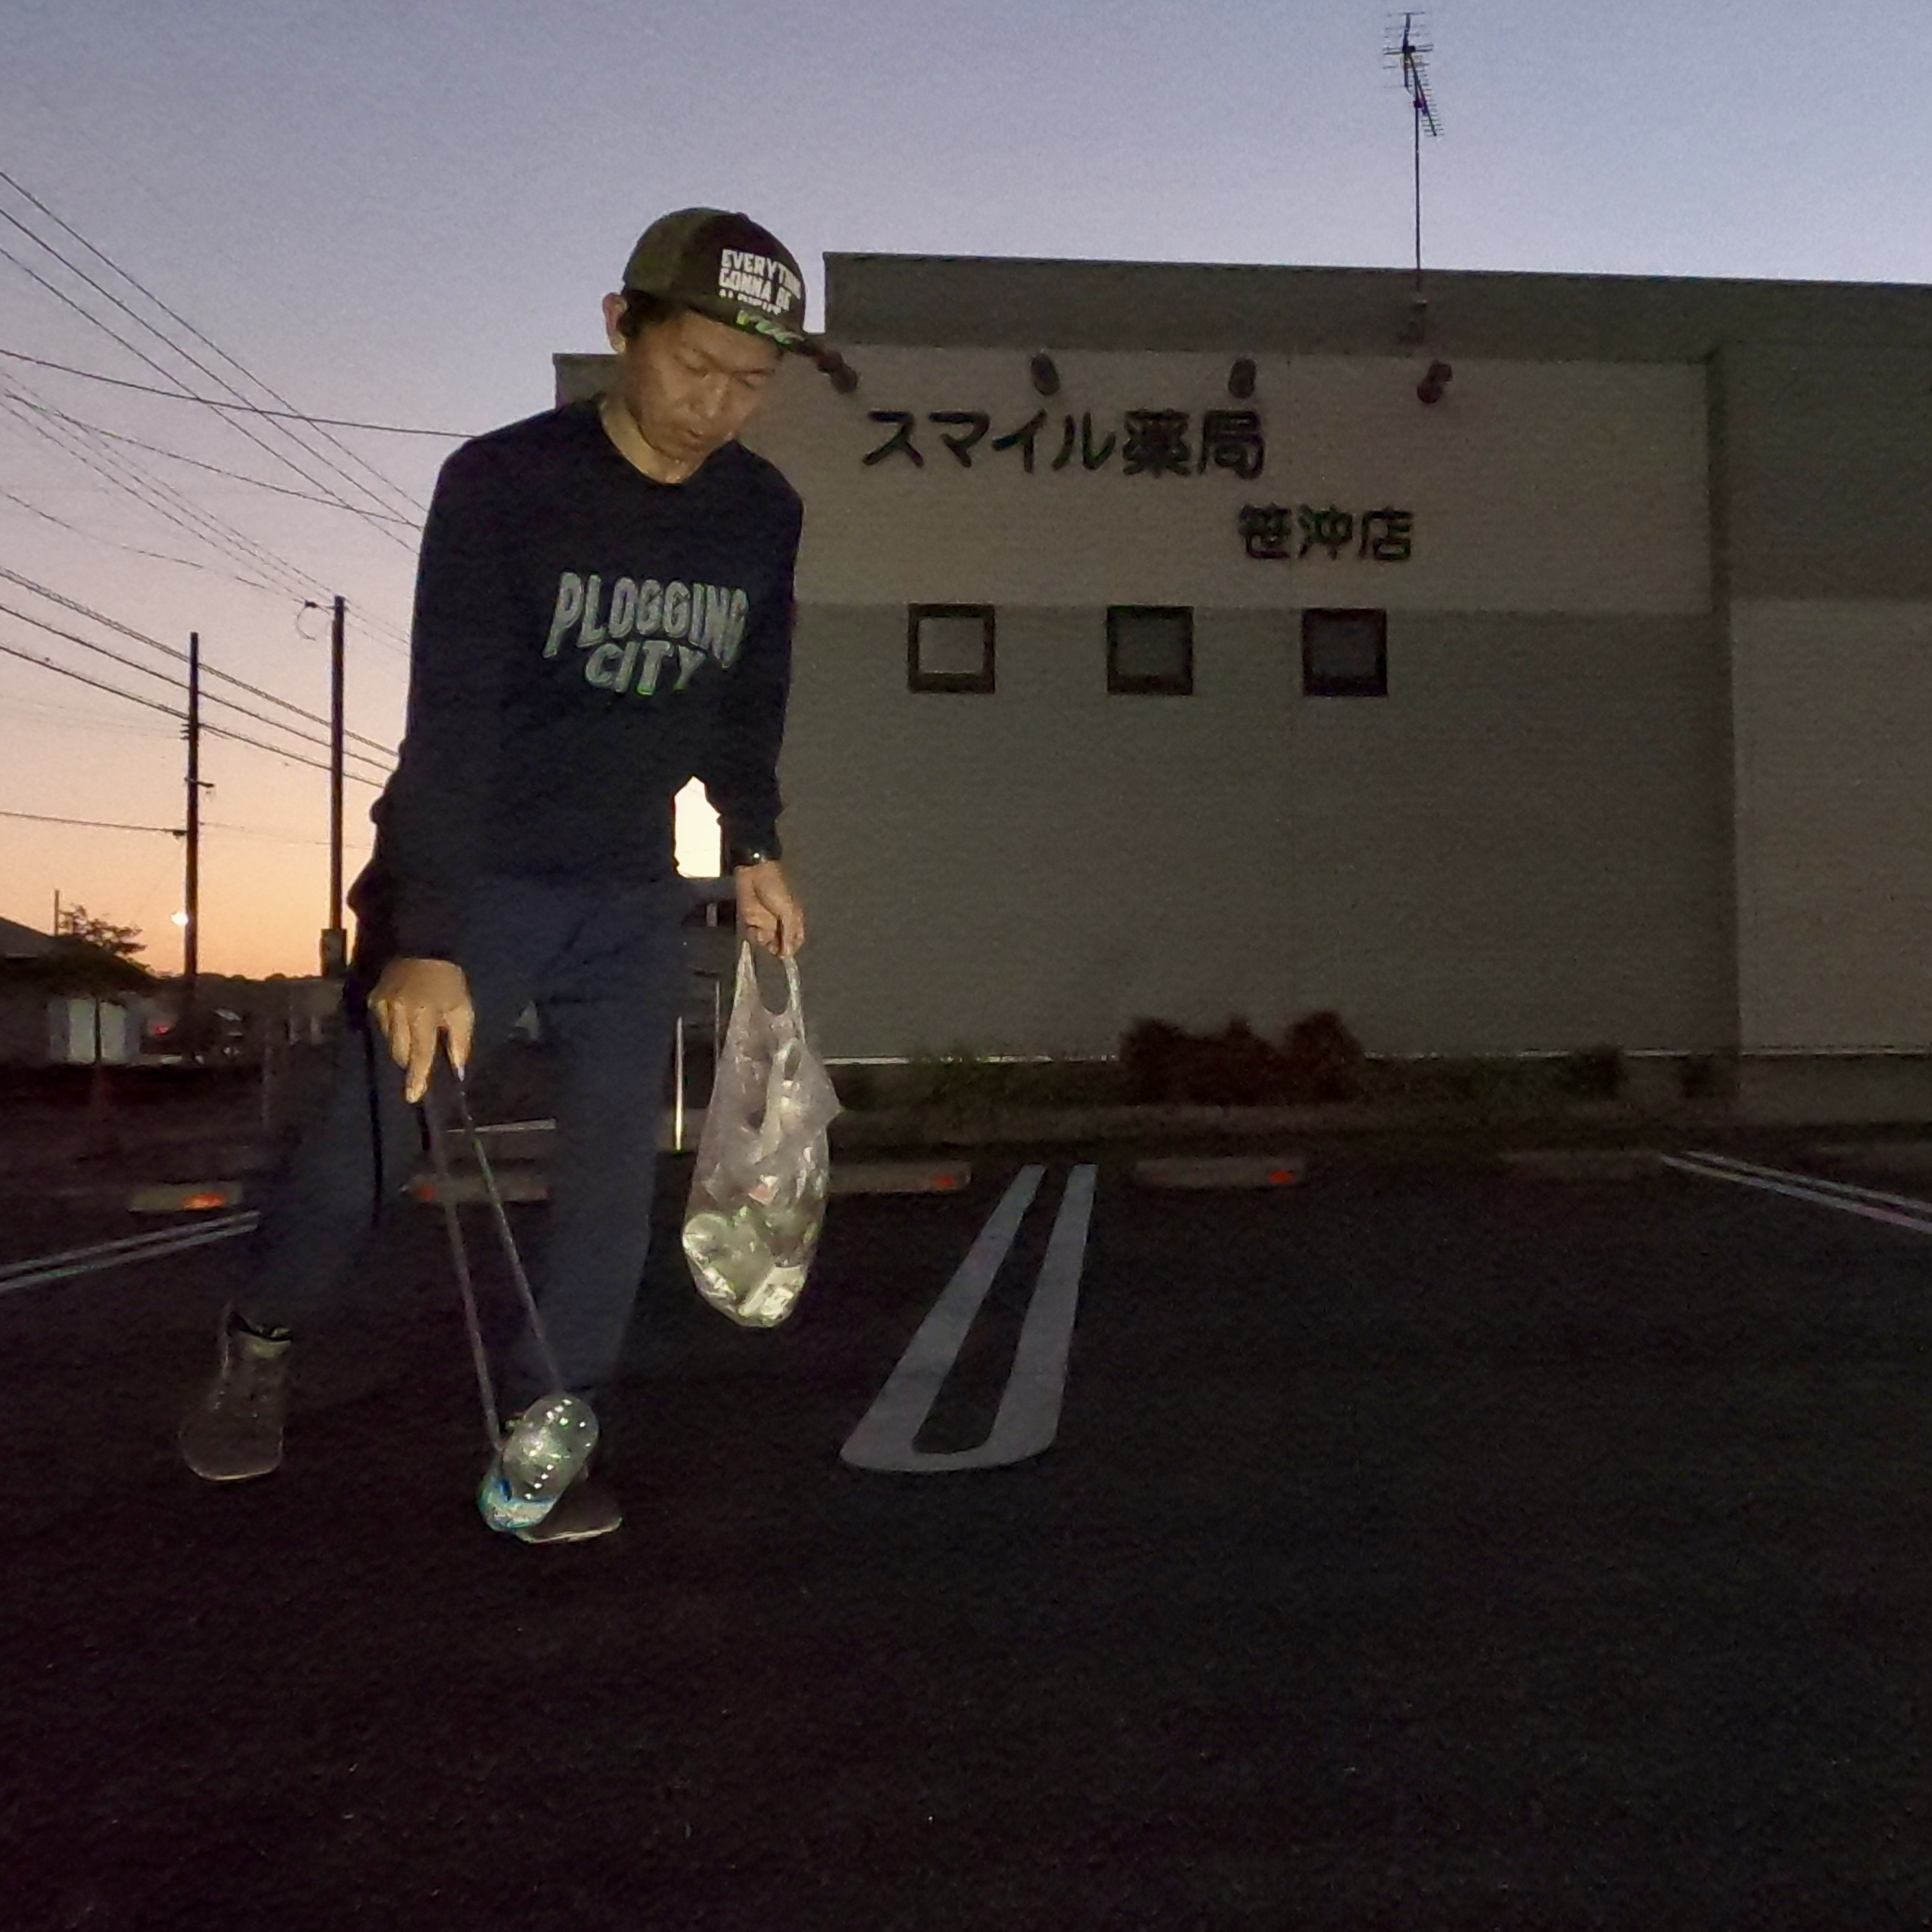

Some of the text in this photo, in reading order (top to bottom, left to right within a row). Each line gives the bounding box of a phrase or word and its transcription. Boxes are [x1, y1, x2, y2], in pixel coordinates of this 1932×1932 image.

[863, 410, 1265, 479] スマイル薬局
[1238, 505, 1412, 561] 笹沖店
[542, 571, 749, 668] PLOGGING
[585, 640, 707, 696] CITY
